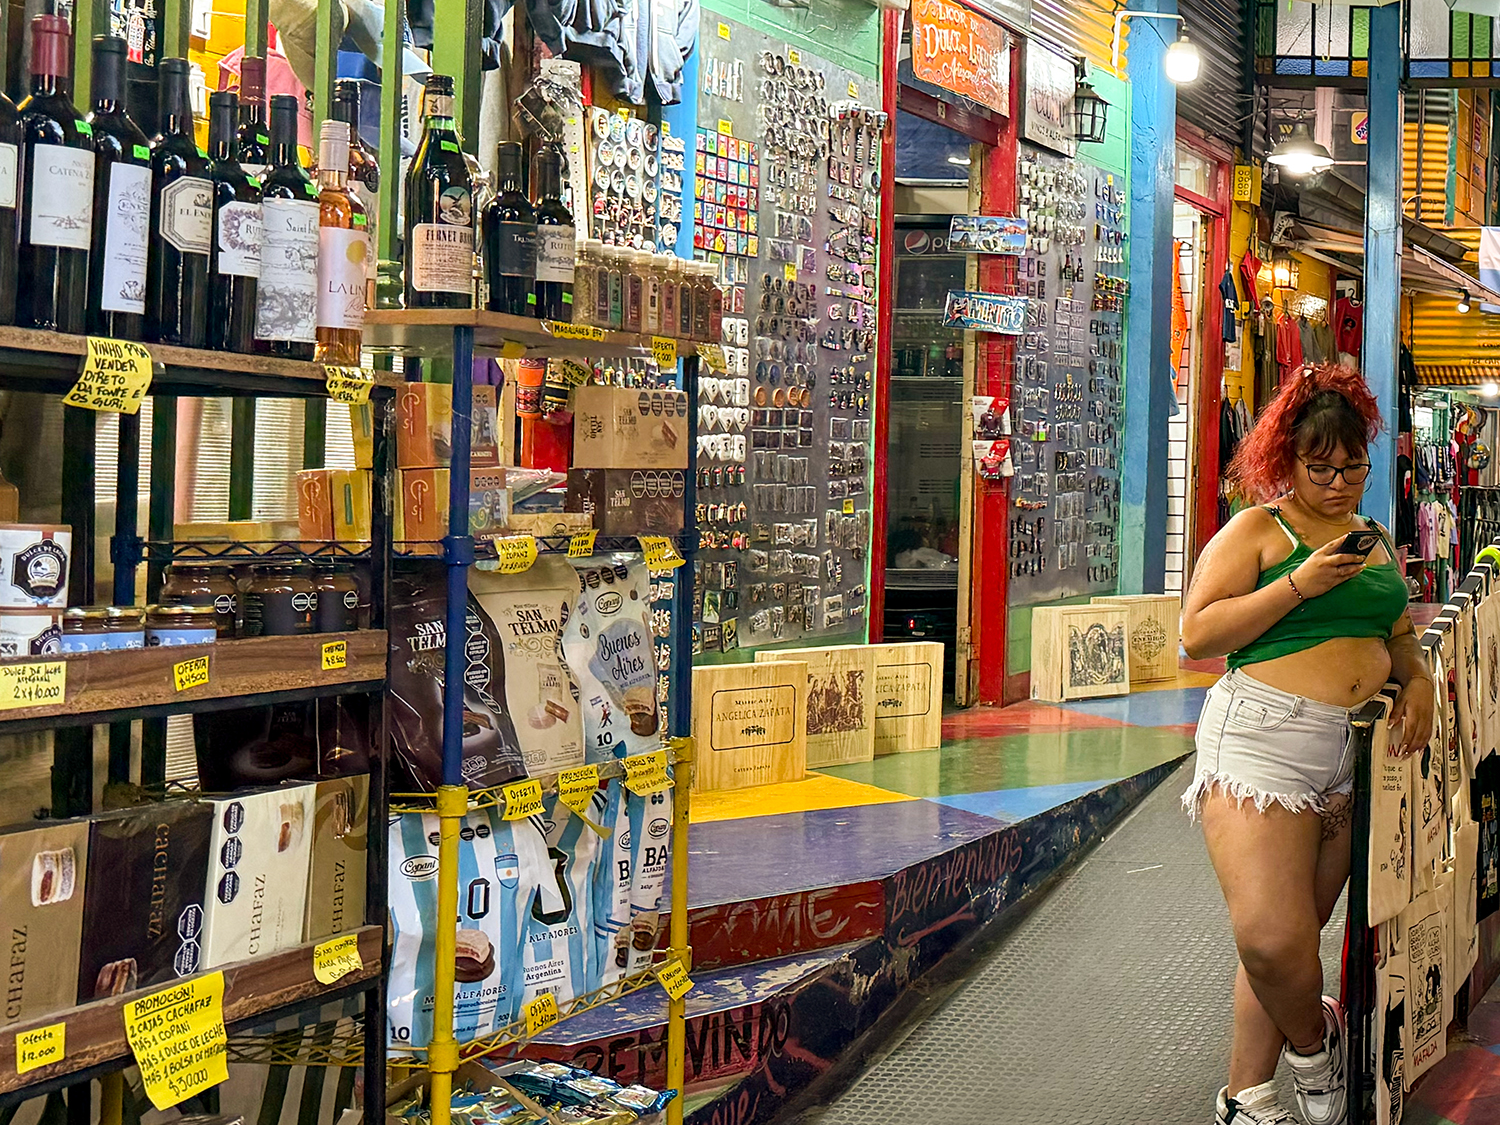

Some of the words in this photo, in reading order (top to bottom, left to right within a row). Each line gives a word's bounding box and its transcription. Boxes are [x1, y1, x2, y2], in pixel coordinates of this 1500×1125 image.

[938, 2, 968, 28] LICOR
[924, 23, 961, 58] DULCE
[426, 229, 457, 242] FERNET
[328, 280, 347, 295] LA
[95, 357, 139, 373] VENDER
[84, 370, 126, 385] DIRETO
[70, 393, 89, 403] OS
[76, 382, 93, 395] DA
[96, 385, 129, 398] FONTE
[516, 608, 543, 623] SAN
[415, 620, 445, 636] SAN
[507, 618, 558, 638] TELMO
[406, 633, 447, 652] TELM
[599, 629, 643, 662] Buenos
[177, 658, 207, 675] OFERTA
[611, 654, 645, 681] Aires
[895, 682, 927, 692] ZAPATA
[716, 708, 757, 723] ANGELICA
[758, 706, 791, 719] ZAPATA
[596, 731, 613, 747] 10
[529, 926, 578, 944] ALFAJORES
[525, 968, 562, 981] Argentina
[455, 984, 508, 1001] ALFAJORES
[129, 1025, 137, 1038] 2
[137, 1015, 164, 1035] CAJAS
[165, 995, 212, 1022] CACHAFAZ
[132, 1036, 150, 1053] MÁS
[160, 1020, 192, 1042] COPANI
[391, 1026, 410, 1040] 10
[140, 1052, 159, 1072] MÁS
[165, 1040, 188, 1057] DULCE
[189, 1036, 201, 1049] DE
[201, 1023, 224, 1043] LECHE
[1413, 1040, 1438, 1067] MAFALDA
[145, 1068, 162, 1088] MÁS
[169, 1055, 194, 1075] BOLSA
